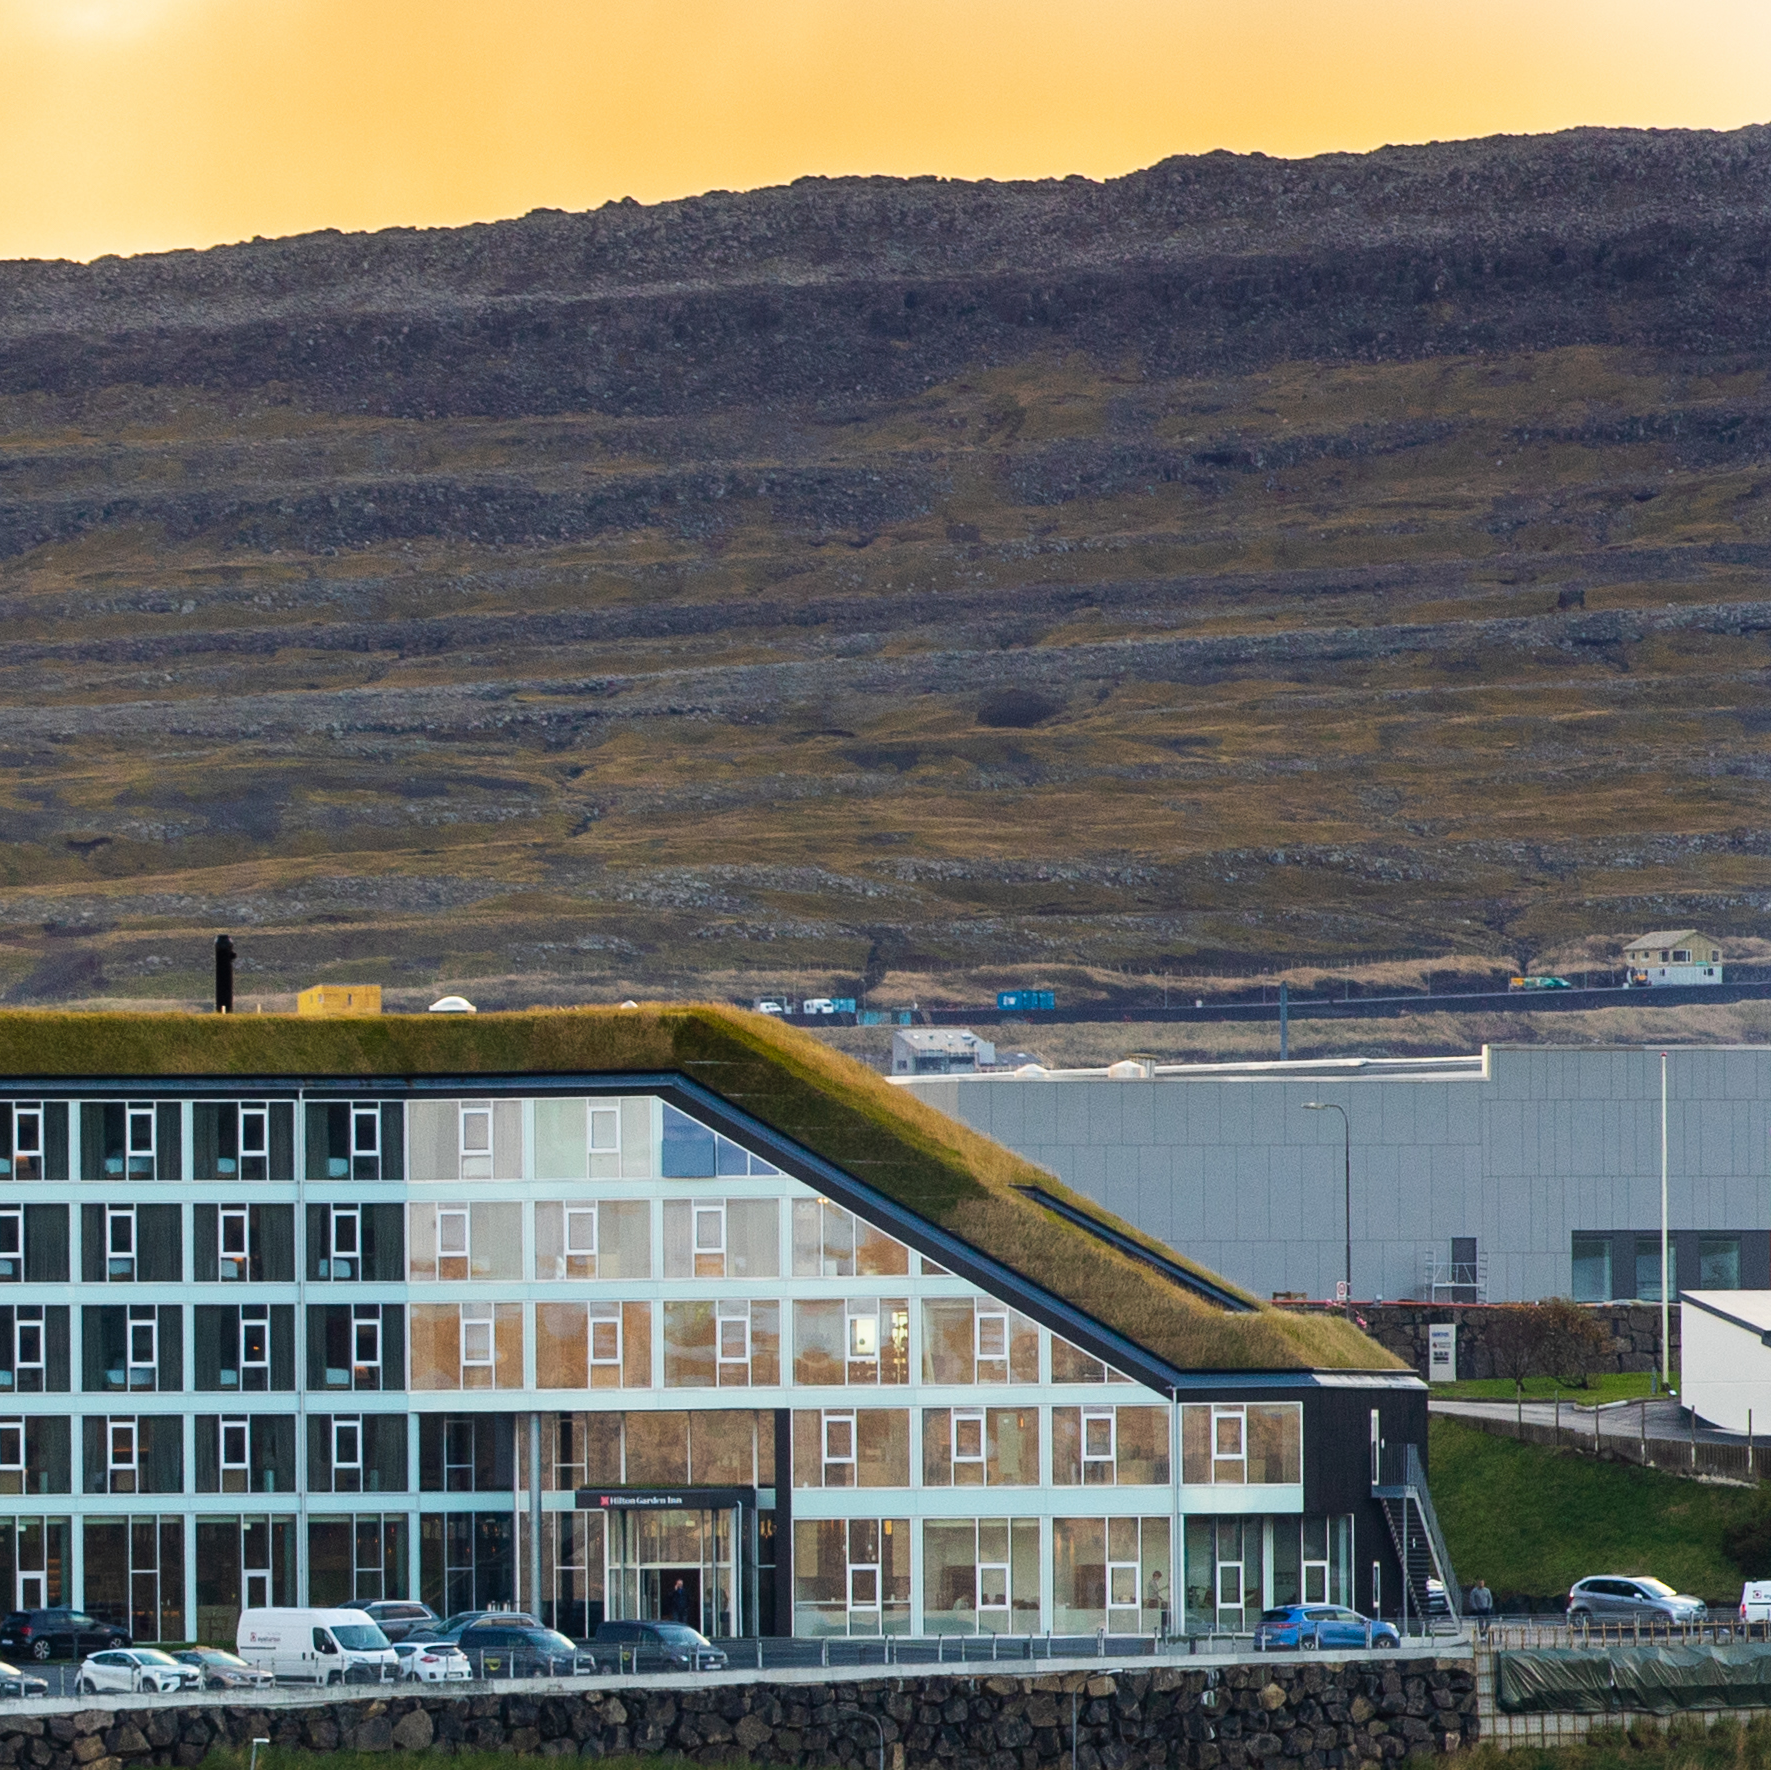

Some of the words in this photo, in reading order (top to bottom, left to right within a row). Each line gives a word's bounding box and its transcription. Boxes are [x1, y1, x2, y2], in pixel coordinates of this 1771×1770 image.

[610, 1496, 636, 1504] Hilton
[636, 1496, 666, 1504] Garden
[667, 1496, 682, 1504] Inn
